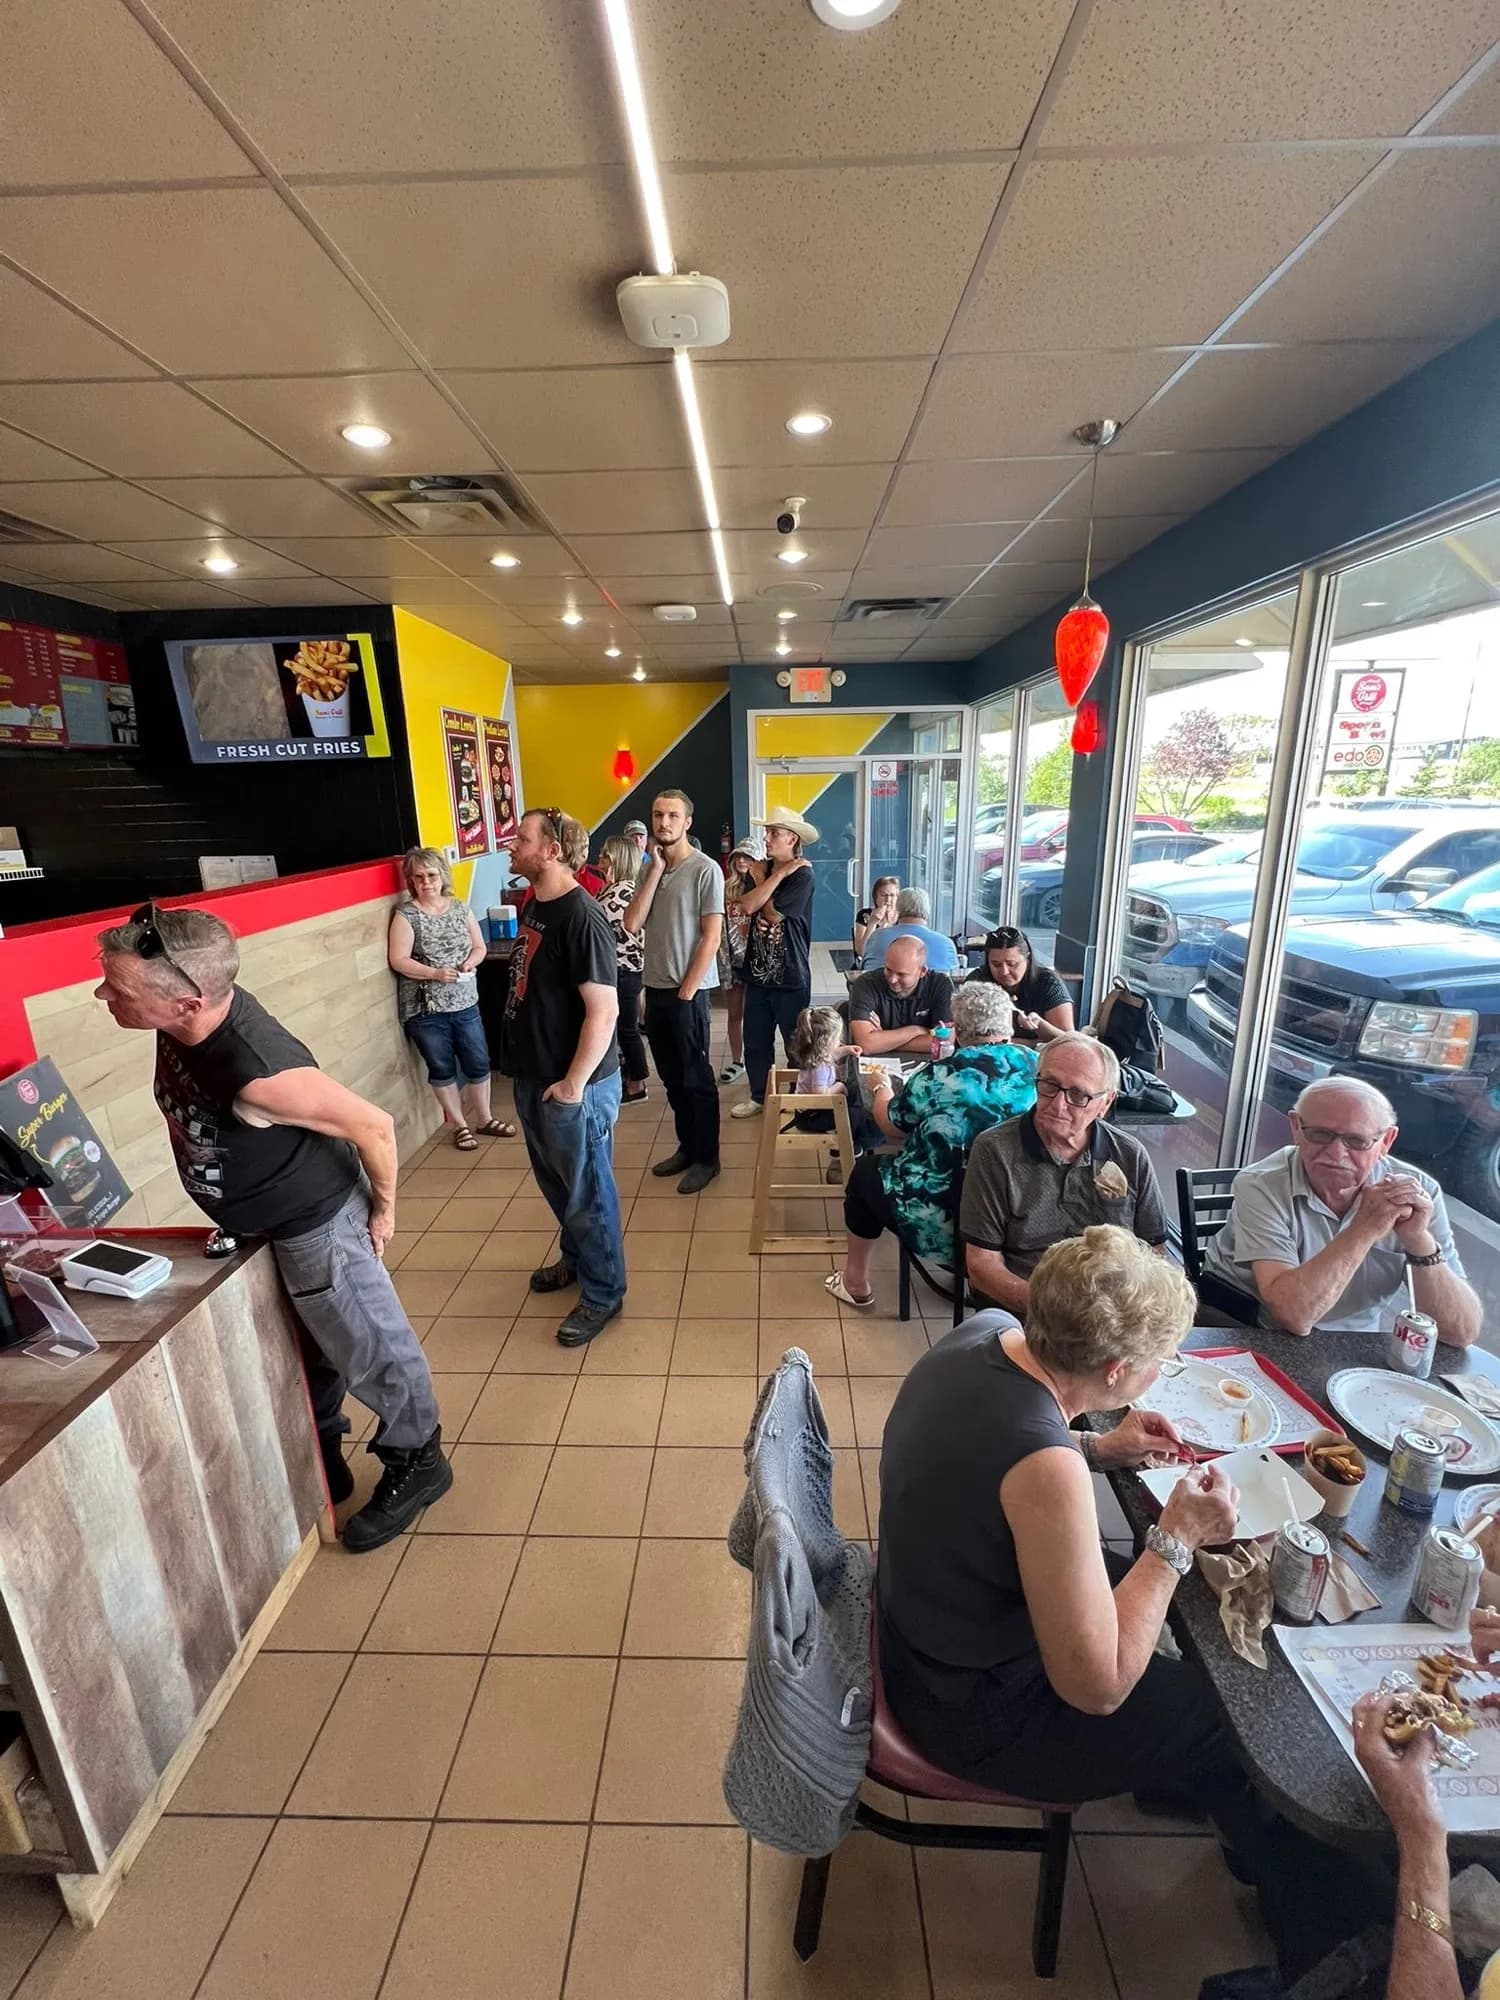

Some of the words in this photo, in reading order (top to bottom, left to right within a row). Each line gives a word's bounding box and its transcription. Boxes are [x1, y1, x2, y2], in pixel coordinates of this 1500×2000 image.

[797, 670, 824, 691] EXIT
[217, 745, 270, 758] FRESH
[275, 743, 308, 756] CUT
[313, 741, 361, 754] FRIES
[1334, 747, 1364, 763] edo
[18, 1116, 44, 1148] Super
[39, 1093, 68, 1121] Burger
